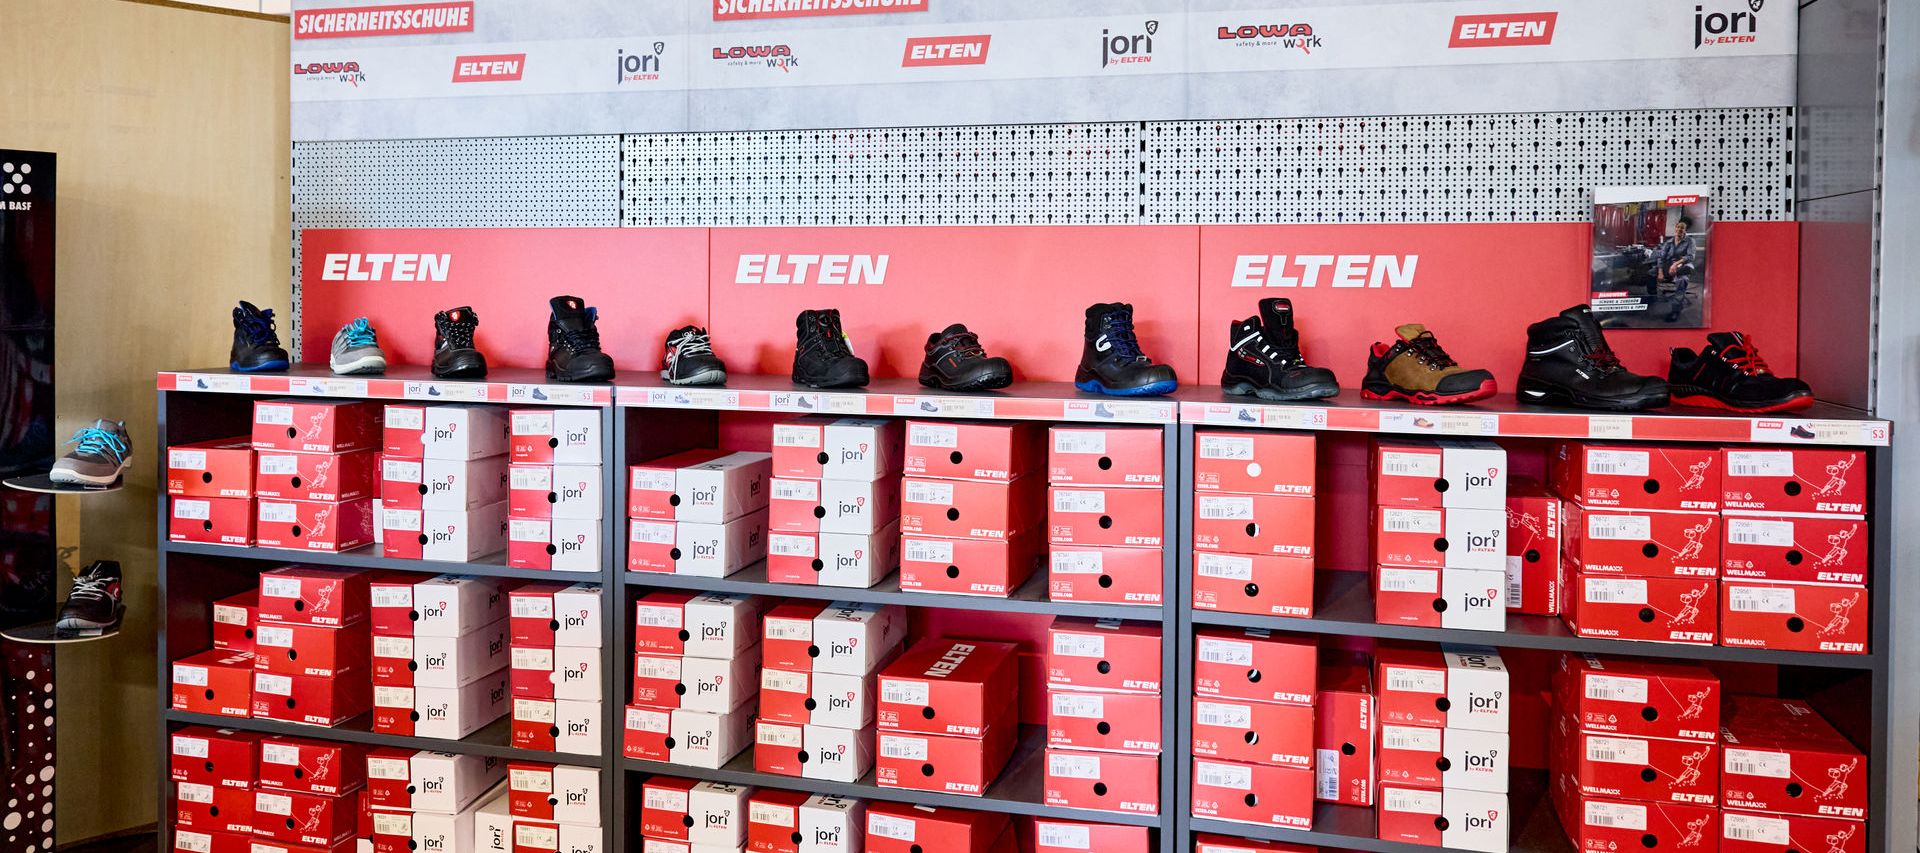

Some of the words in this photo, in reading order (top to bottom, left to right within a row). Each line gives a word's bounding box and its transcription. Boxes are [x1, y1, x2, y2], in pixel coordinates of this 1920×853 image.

[298, 6, 469, 34] SICHERHEITSSCHUHE
[1218, 23, 1313, 40] LOWA
[1458, 20, 1547, 40] ELTEN
[1695, 6, 1758, 49] jori
[1704, 37, 1717, 46] by
[1718, 35, 1756, 44] ELTEN
[712, 44, 791, 58] LOWA
[910, 42, 983, 60] ELTEN
[1103, 28, 1153, 69] jori
[294, 61, 360, 75] LOWA
[459, 60, 519, 76] ELTEN
[618, 49, 660, 85] jori
[633, 73, 660, 81] ELTEN
[9, 201, 32, 210] BASF
[321, 253, 452, 282] ELTEN
[734, 254, 889, 285] ELTEN
[1231, 254, 1419, 288] ELTEN
[408, 384, 421, 395] jori
[512, 386, 526, 398] jori
[583, 392, 591, 400] S3
[727, 396, 736, 404] S3
[774, 394, 791, 407] jori
[1159, 409, 1169, 418] S3
[1312, 414, 1324, 424] S3
[1758, 421, 1783, 429] ELTEN
[434, 426, 452, 442] jori
[566, 430, 586, 446] jori
[1871, 428, 1885, 440] S3
[303, 444, 330, 452] ELTEN
[842, 447, 863, 464] jori
[974, 469, 1007, 479] ELTEN
[1124, 474, 1161, 483] ELTEN
[432, 479, 451, 495] jori
[1465, 472, 1492, 492] jori
[220, 489, 248, 497] ELTEN
[562, 486, 582, 502] jori
[1273, 484, 1312, 494] ELTEN
[309, 492, 335, 500] ELTEN
[692, 487, 714, 506] jori
[1587, 498, 1620, 506] WELLMAXX
[838, 500, 860, 518] jori
[1680, 500, 1717, 510] ELTEN
[1724, 501, 1765, 509] WELLMAXX
[1815, 502, 1862, 513] ELTEN
[1547, 502, 1556, 539] ELTEN
[432, 530, 451, 545] jori
[970, 528, 1004, 538] ELTEN
[221, 535, 246, 544] ELTEN
[308, 541, 334, 549] ELTEN
[1125, 536, 1161, 545] ELTEN
[1467, 531, 1496, 553] jori
[561, 538, 581, 554] jori
[693, 541, 715, 560] jori
[1273, 544, 1311, 554] ELTEN
[836, 553, 858, 571] jori
[1585, 564, 1623, 572] WELLMAXX
[1674, 566, 1717, 576] ELTEN
[1726, 569, 1766, 578] WELLMAXX
[1817, 571, 1863, 582] ELTEN
[970, 583, 1004, 593] ELTEN
[1124, 592, 1161, 602] ELTEN
[1464, 592, 1491, 613] jori
[424, 605, 443, 621] jori
[1271, 604, 1309, 615] ELTEN
[311, 616, 338, 625] ELTEN
[565, 614, 584, 630] jori
[701, 622, 724, 641] jori
[1580, 627, 1619, 636] WELLMAXX
[1669, 631, 1713, 642] ELTEN
[1725, 638, 1766, 646] WELLMAXX
[1820, 641, 1864, 652] ELTEN
[831, 641, 852, 658] jori
[426, 654, 444, 670] jori
[923, 643, 976, 678] ELTEN
[304, 667, 332, 677] ELTEN
[564, 666, 584, 682] jori
[698, 679, 719, 695] jori
[1122, 679, 1159, 690] ELTEN
[829, 694, 850, 712] jori
[1273, 691, 1311, 703] ELTEN
[1469, 692, 1499, 714] jori
[221, 707, 248, 716] ELTEN
[427, 705, 446, 721] jori
[1359, 698, 1368, 730] ELTEN
[304, 715, 330, 724] ELTEN
[567, 720, 587, 736] jori
[946, 724, 980, 735] ELTEN
[1585, 722, 1618, 731] WELLMAXX
[1678, 729, 1716, 739] ELTEN
[687, 731, 709, 750] jori
[1123, 740, 1160, 751] ELTEN
[820, 747, 841, 764] jori
[1271, 753, 1310, 764] ELTEN
[1464, 751, 1494, 772] jori
[221, 779, 248, 788] ELTEN
[310, 784, 336, 793] ELTEN
[423, 777, 442, 794] jori
[945, 782, 979, 793] ELTEN
[1582, 785, 1621, 796] WELLMAXX
[566, 789, 586, 806] jori
[1671, 792, 1714, 804] ELTEN
[1119, 801, 1157, 812] ELTEN
[1726, 799, 1767, 809] WELLMAXX
[1818, 805, 1864, 817] ELTEN
[705, 810, 728, 828] jori
[1272, 814, 1310, 826] ELTEN
[1465, 812, 1492, 832] jori
[227, 823, 252, 832] ELTEN
[302, 835, 328, 845] ELTEN
[491, 828, 502, 850] jori
[815, 826, 838, 845] jori
[424, 835, 443, 851] jori
